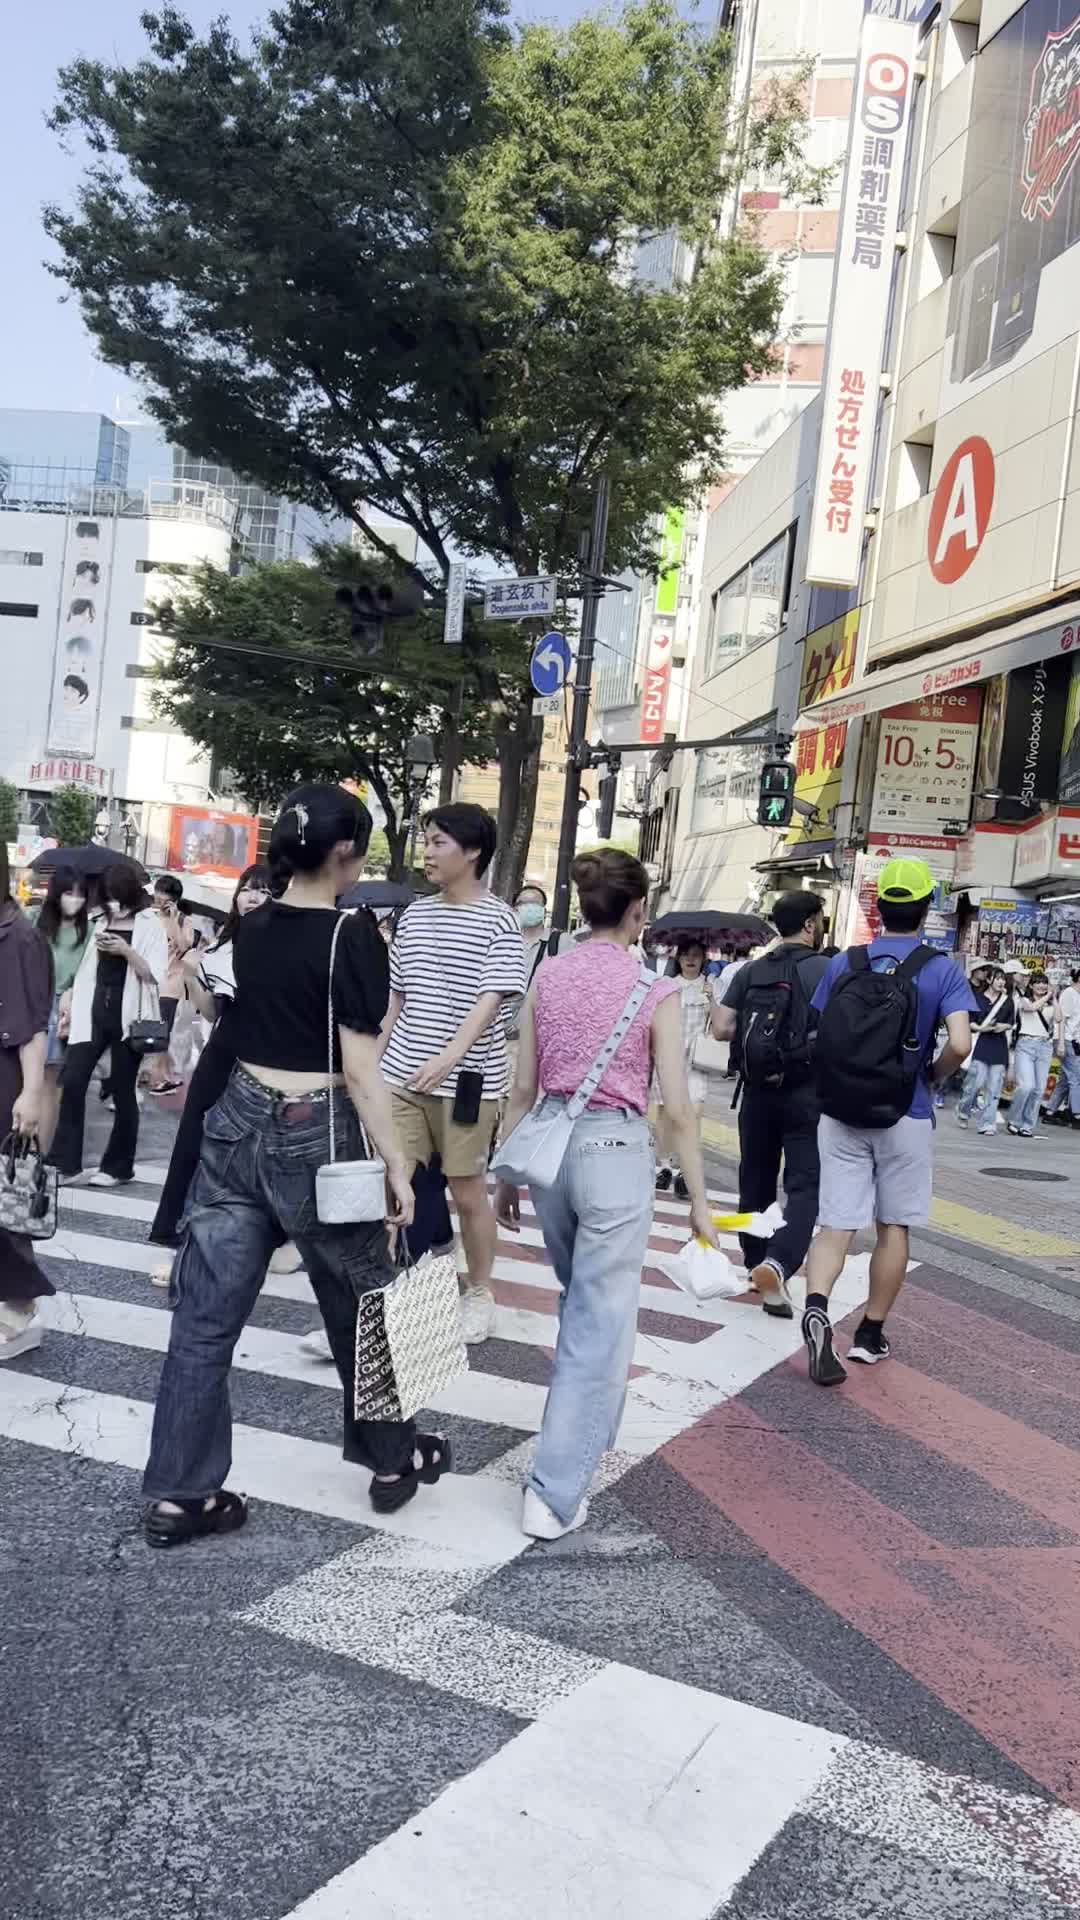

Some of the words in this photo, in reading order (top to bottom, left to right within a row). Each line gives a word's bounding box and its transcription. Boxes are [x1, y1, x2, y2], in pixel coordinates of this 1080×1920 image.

[825, 368, 867, 535] 処方せん受付
[934, 453, 981, 566] A
[645, 675, 665, 720] アコム
[884, 735, 914, 767] 10
[935, 738, 956, 769] 5
[1024, 708, 1043, 769] Vivobook
[1020, 772, 1036, 808] ASUS
